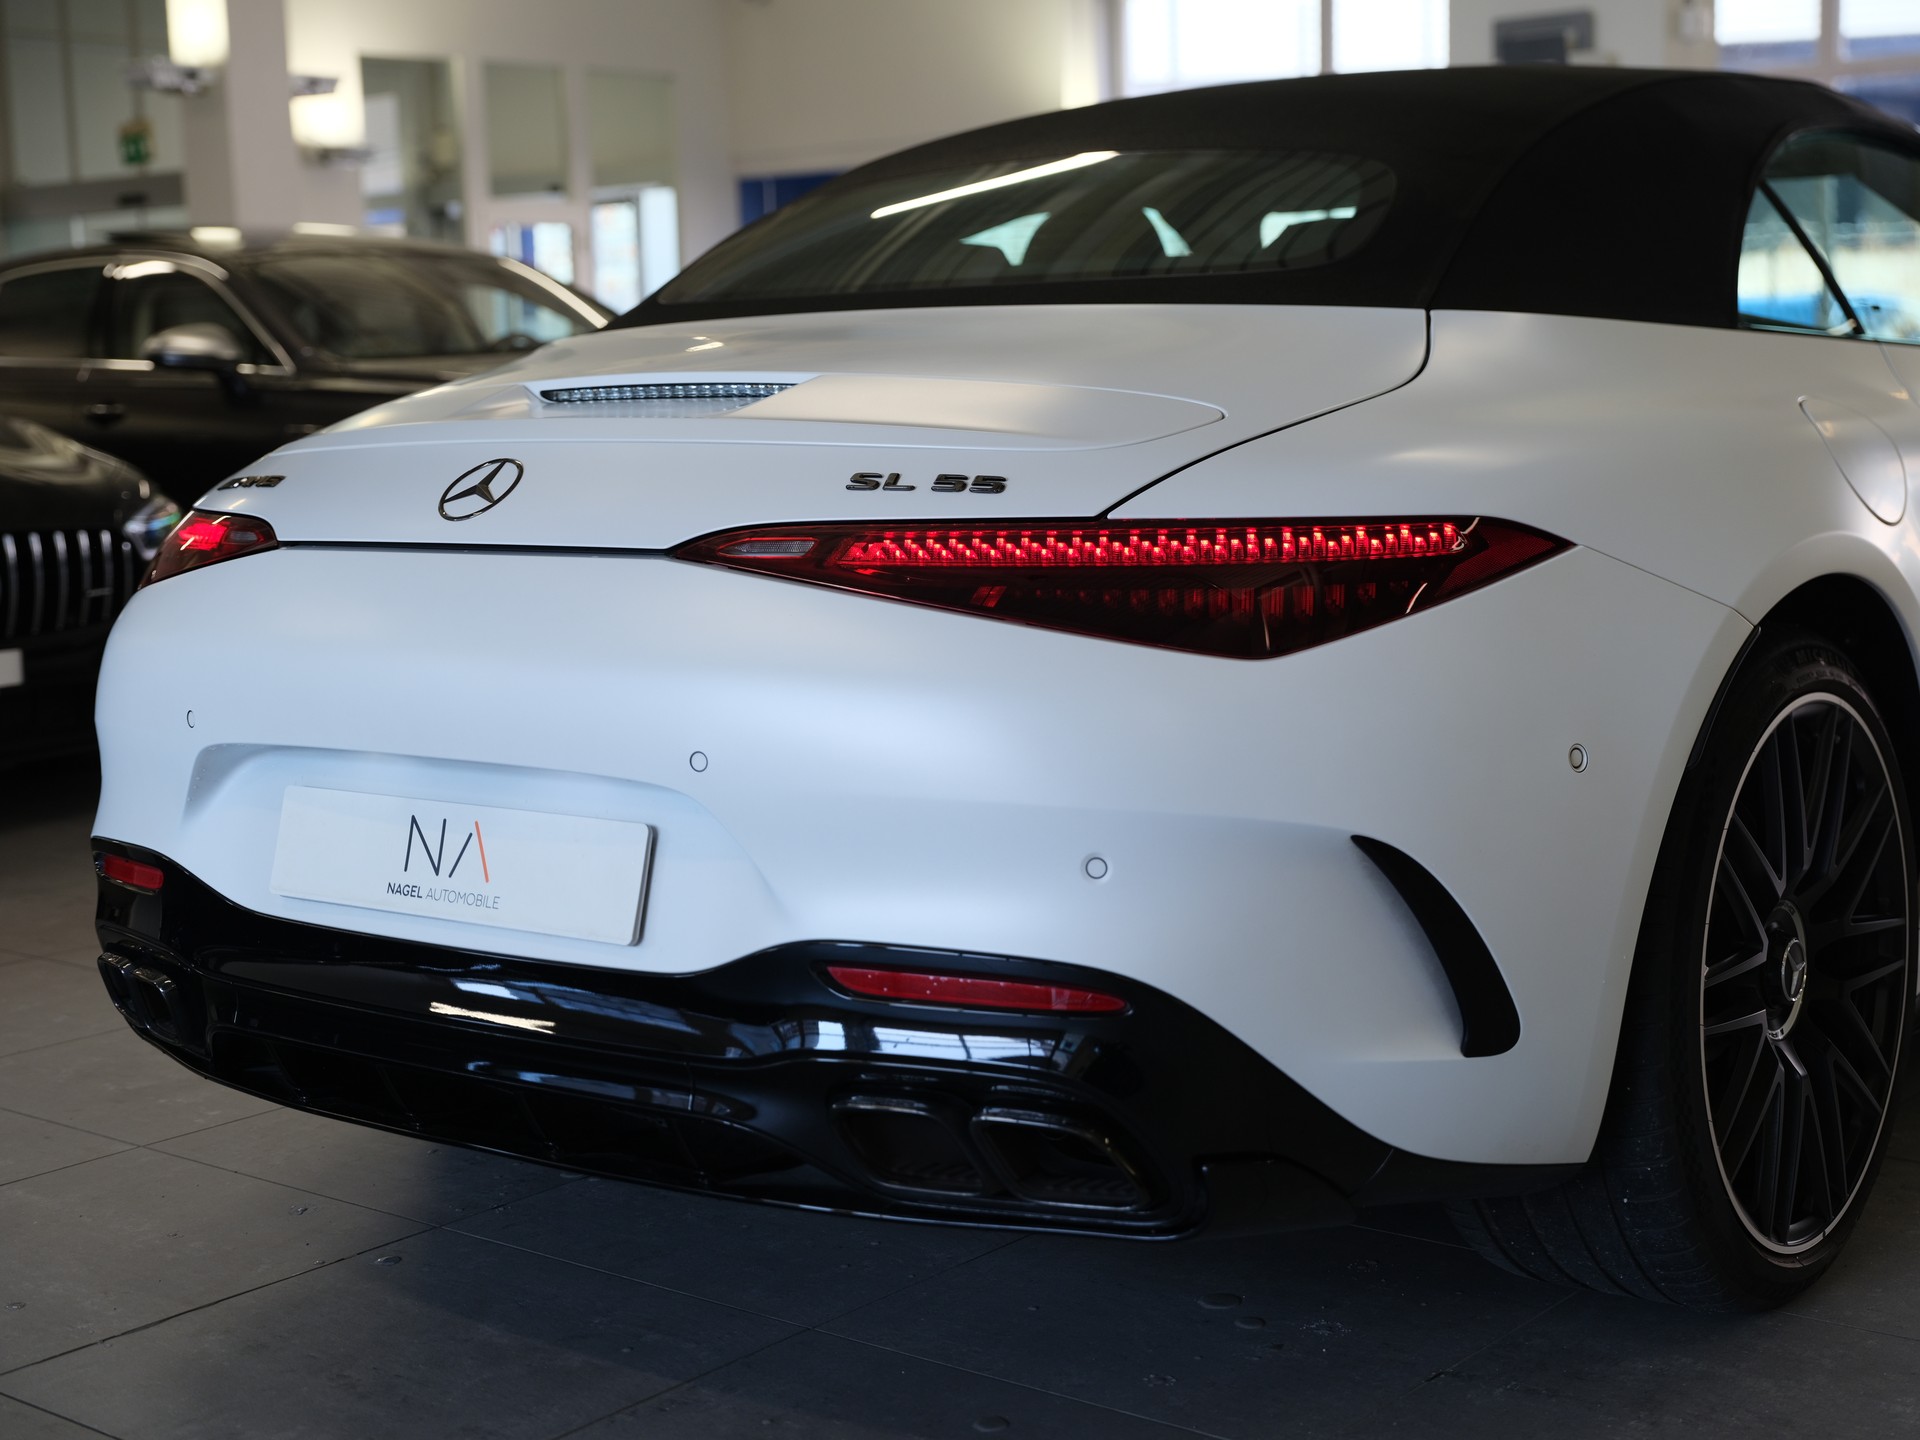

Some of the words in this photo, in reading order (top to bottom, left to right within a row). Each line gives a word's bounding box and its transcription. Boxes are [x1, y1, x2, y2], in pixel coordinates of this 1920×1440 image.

[845, 472, 916, 491] SL
[931, 473, 1007, 494] 55
[403, 814, 489, 883] NA
[387, 882, 423, 899] NAGEL
[425, 887, 501, 910] AUTOMOBILE
